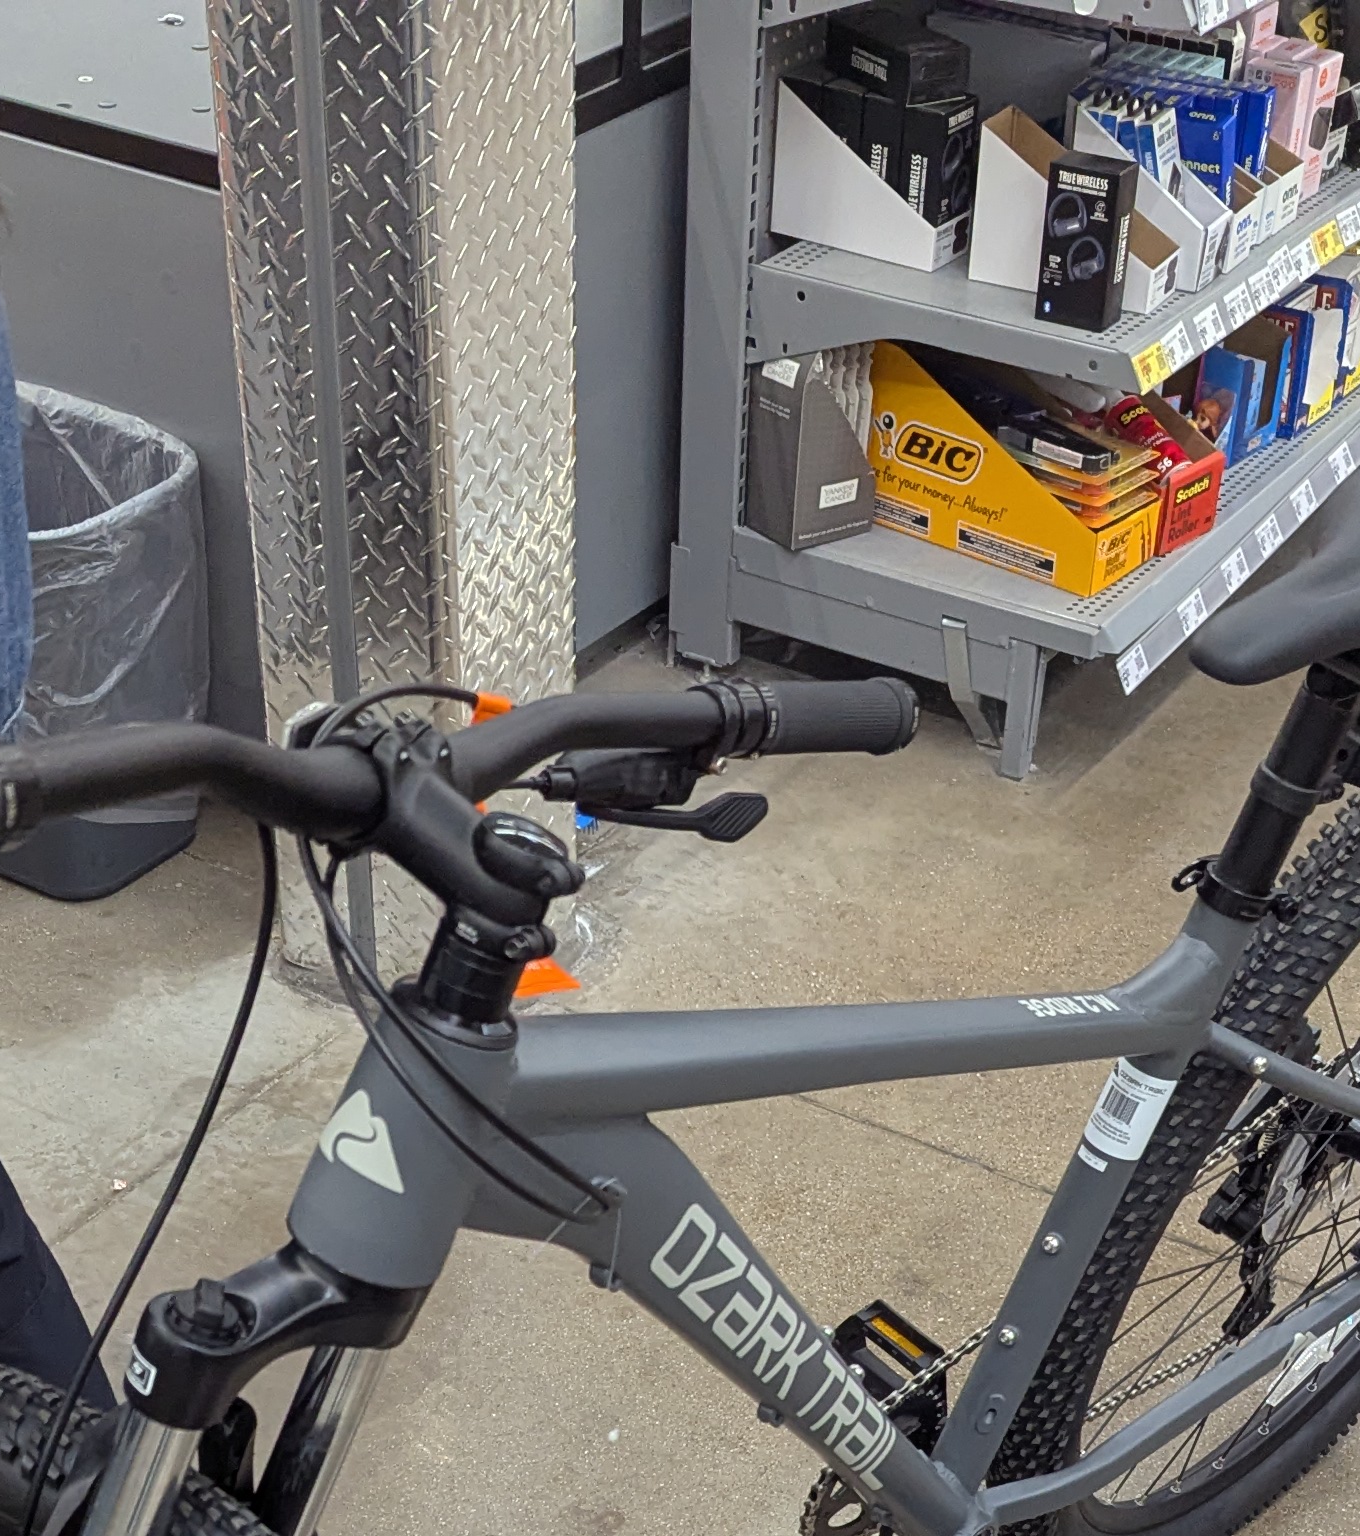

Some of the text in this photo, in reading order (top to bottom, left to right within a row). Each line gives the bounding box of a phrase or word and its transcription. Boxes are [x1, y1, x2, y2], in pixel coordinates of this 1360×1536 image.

[908, 153, 922, 196] WIRELESS
[1058, 169, 1076, 182] TRUE
[1076, 174, 1109, 191] WIRELESS
[1157, 456, 1173, 473] 56
[882, 465, 897, 483] for
[898, 477, 921, 493] your
[1175, 477, 1210, 504] Scotch
[1171, 502, 1192, 525] Lint
[1168, 517, 1199, 543] Roller
[1018, 996, 1087, 1018] RIDGE
